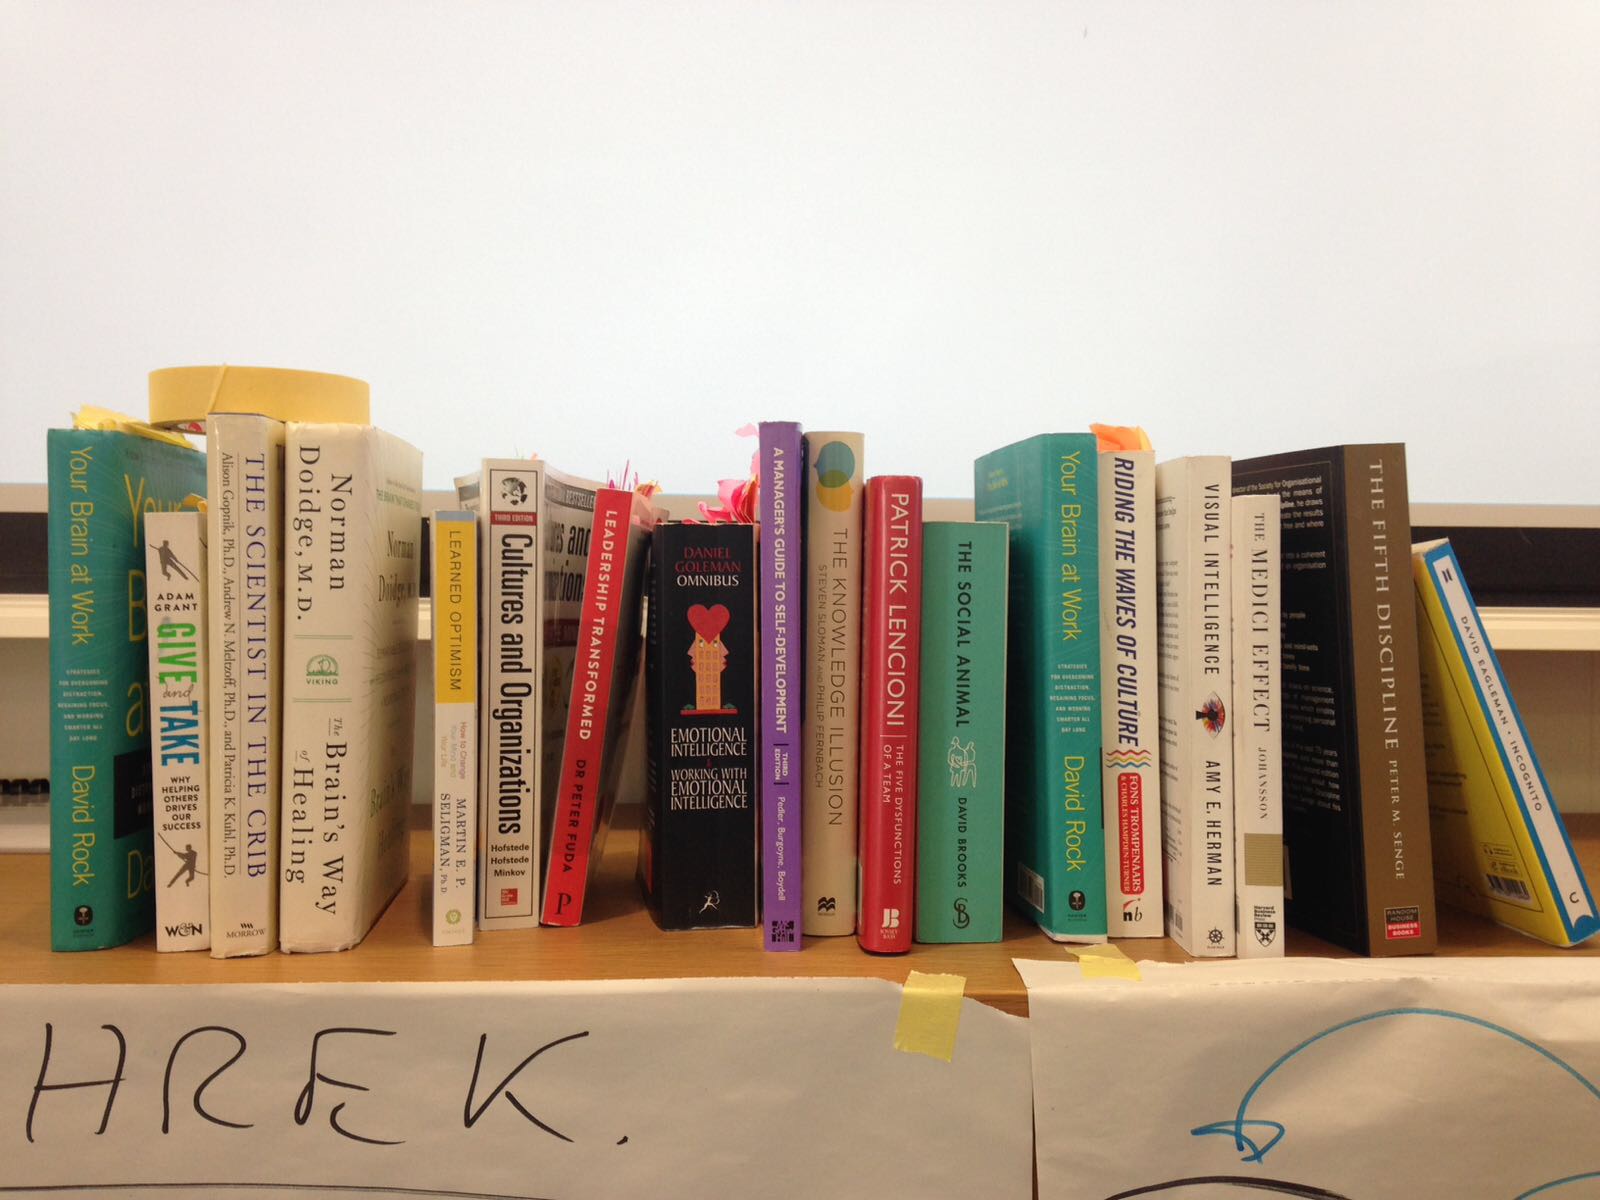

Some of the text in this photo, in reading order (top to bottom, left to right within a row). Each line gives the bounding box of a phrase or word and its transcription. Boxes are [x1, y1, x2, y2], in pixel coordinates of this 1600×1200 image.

[222, 453, 233, 487] Alison
[220, 491, 235, 534] Gopnik,
[293, 446, 321, 620] Doidge, M.D.
[329, 474, 352, 590] Norman
[69, 446, 95, 645] Your Brain at Work
[674, 560, 741, 573] GOLEMAN
[683, 547, 732, 559] DANIEL
[1060, 450, 1083, 641] Your Brain at Work
[154, 602, 197, 612] GRANT
[157, 593, 194, 601] ADAM
[223, 579, 235, 621] Andrew
[676, 574, 740, 587] OMNIBUS
[773, 447, 787, 734] A MANAGER'S GUIDE TO SELF-DEVELOPMENT
[817, 564, 827, 609] STEVEN
[1115, 457, 1139, 747] RIDING THE WAVES OF CULTURE
[1204, 484, 1220, 674] VISUAL INTELLIGENCE
[224, 624, 235, 637] N.
[449, 530, 462, 691] LEARNED OPTIMISM
[579, 510, 617, 740] LEADERSHIP TRANSFORMED
[816, 611, 826, 662] SLOMAN
[886, 493, 909, 727] PATRICK LENCIONI
[956, 541, 972, 728] THE SOCIAL ANIMAL
[1251, 512, 1270, 732] THE MEDICI EFFECT
[157, 622, 197, 685] GIVE
[223, 642, 237, 689] Meltzoff,
[245, 454, 267, 878] THE SCIENTIST IN THE CRIB
[828, 527, 848, 826] THE KNOWLEDGE ILLUSION
[1369, 459, 1405, 880] THE FIFTH DISCIPLINE PETER M. SENGE
[163, 684, 192, 699] and
[492, 533, 533, 834] Cultures and Organizations
[816, 685, 825, 722] PHILIP
[159, 701, 200, 767] TAKE
[224, 729, 236, 750] and
[671, 727, 747, 744] EMOTIONAL
[1461, 615, 1543, 812] DAVID EAGLEMAN INCOGNITO
[224, 754, 236, 794] Patricia
[459, 721, 467, 780] How to Change
[671, 742, 747, 757] INTELLIGENCE
[671, 767, 747, 781] WORKING WITH
[815, 726, 825, 789] FERNBACH
[882, 744, 892, 803] OF A TEAM
[161, 784, 200, 794] HELPING
[163, 794, 199, 803] OTHERS
[165, 804, 198, 812] DRIVES
[170, 776, 191, 784] WHY
[224, 797, 236, 810] K.
[670, 795, 748, 811] INTELLIGENCE
[671, 780, 748, 797] EMOTIONAL
[1120, 782, 1128, 818] CHARLES
[1257, 747, 1269, 819] JOHANSSON
[72, 765, 95, 887] David Rock
[162, 822, 201, 831] SUCCESS
[172, 813, 191, 821] OUR
[223, 813, 236, 842] Kuhl,
[285, 750, 314, 885] of Healing
[315, 718, 347, 915] The Brain's Way
[439, 793, 451, 871] SELIGMAN,
[455, 798, 467, 889] MARTIN E. P.
[562, 759, 586, 873] DR PETER FUDA
[893, 744, 904, 885] THE FIVE DYSFUNCTIONS
[957, 797, 968, 888] DAVID BROOKS
[1064, 756, 1086, 872] David Rock
[1129, 775, 1142, 892] FONS TROMPENAARS
[1205, 760, 1222, 886] AMY E. HERMAN
[490, 843, 530, 853] Hofstede
[490, 855, 529, 865] Hofstede
[494, 867, 526, 878] Minkov
[775, 796, 786, 902] Pedler, Burgoyne, Boydell
[226, 928, 266, 939] MORROW
